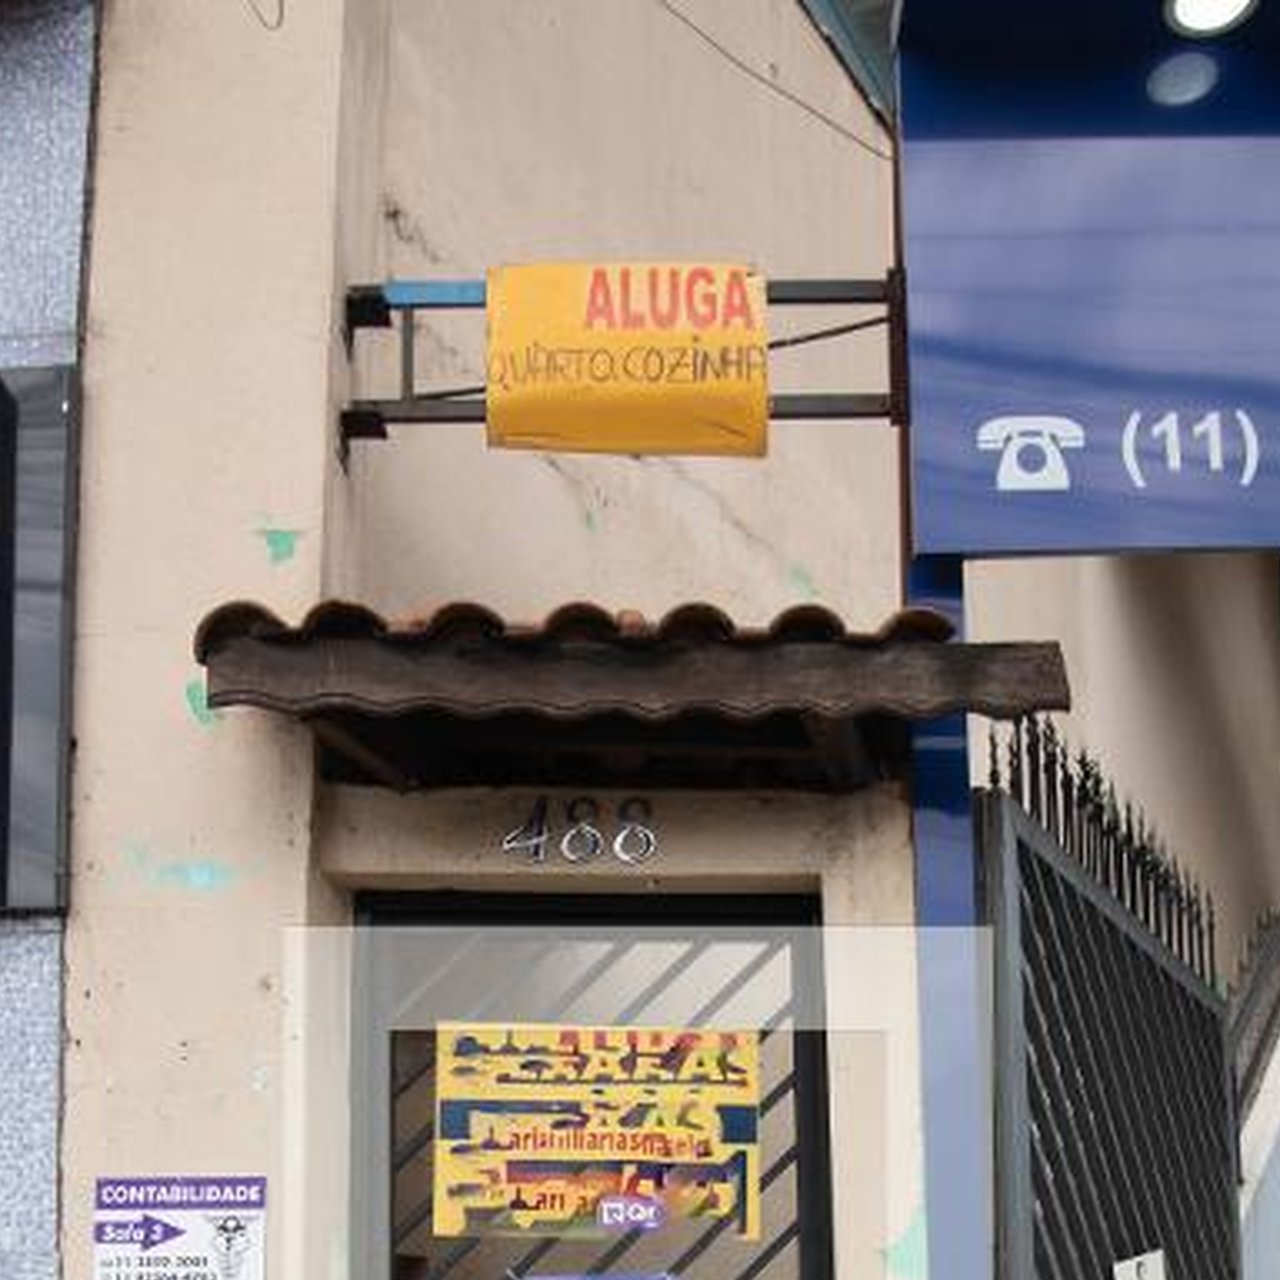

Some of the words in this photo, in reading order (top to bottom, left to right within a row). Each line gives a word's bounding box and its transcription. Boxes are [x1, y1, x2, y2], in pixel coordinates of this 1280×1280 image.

[586, 266, 754, 331] ALUGA
[1122, 409, 1260, 488] (11)
[102, 1185, 261, 1203] CONTABILIDADE
[102, 1223, 145, 1241] Sala
